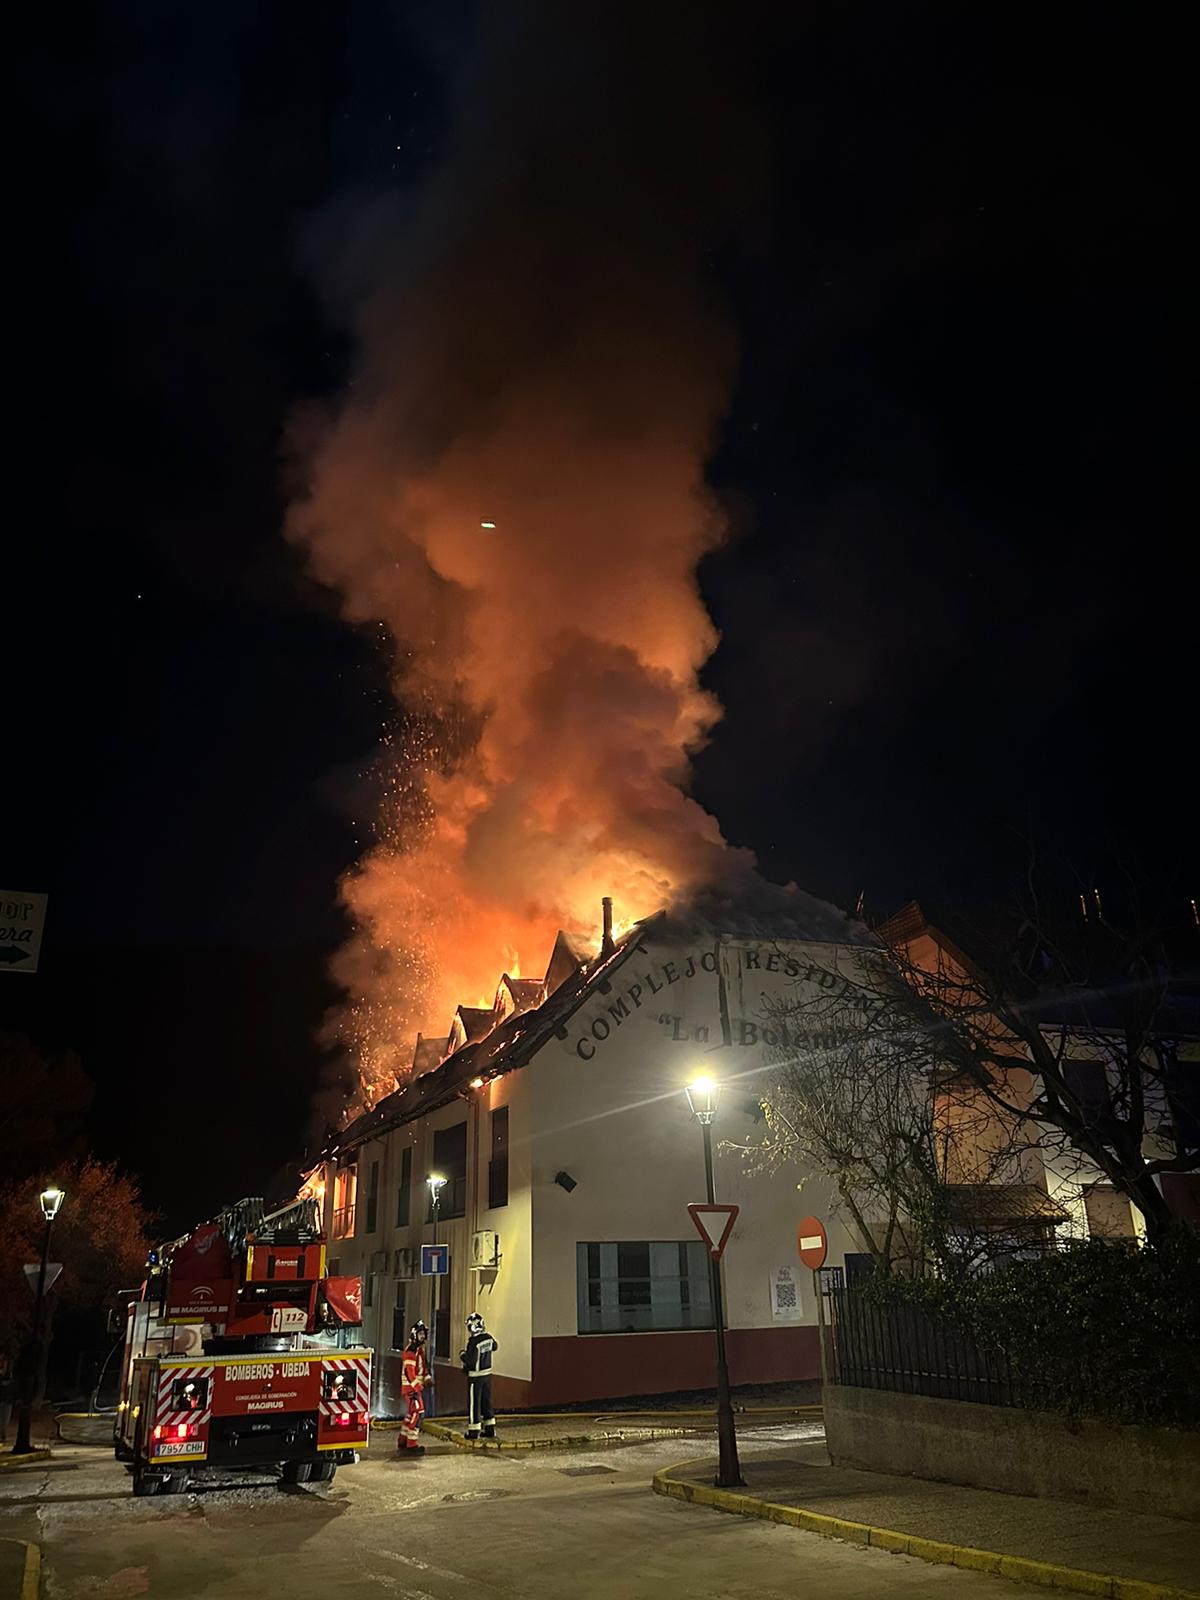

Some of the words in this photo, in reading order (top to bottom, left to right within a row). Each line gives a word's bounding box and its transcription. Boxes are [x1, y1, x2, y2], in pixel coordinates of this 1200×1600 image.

[576, 951, 717, 1061] COMPLEJO
[181, 1306, 218, 1314] MAGIRUS
[285, 1312, 305, 1322] 112
[225, 1364, 274, 1382] BOMBEROS
[247, 1401, 284, 1410] MAGIRUS
[161, 1443, 184, 1454] 7957
[186, 1442, 203, 1453] CHH
